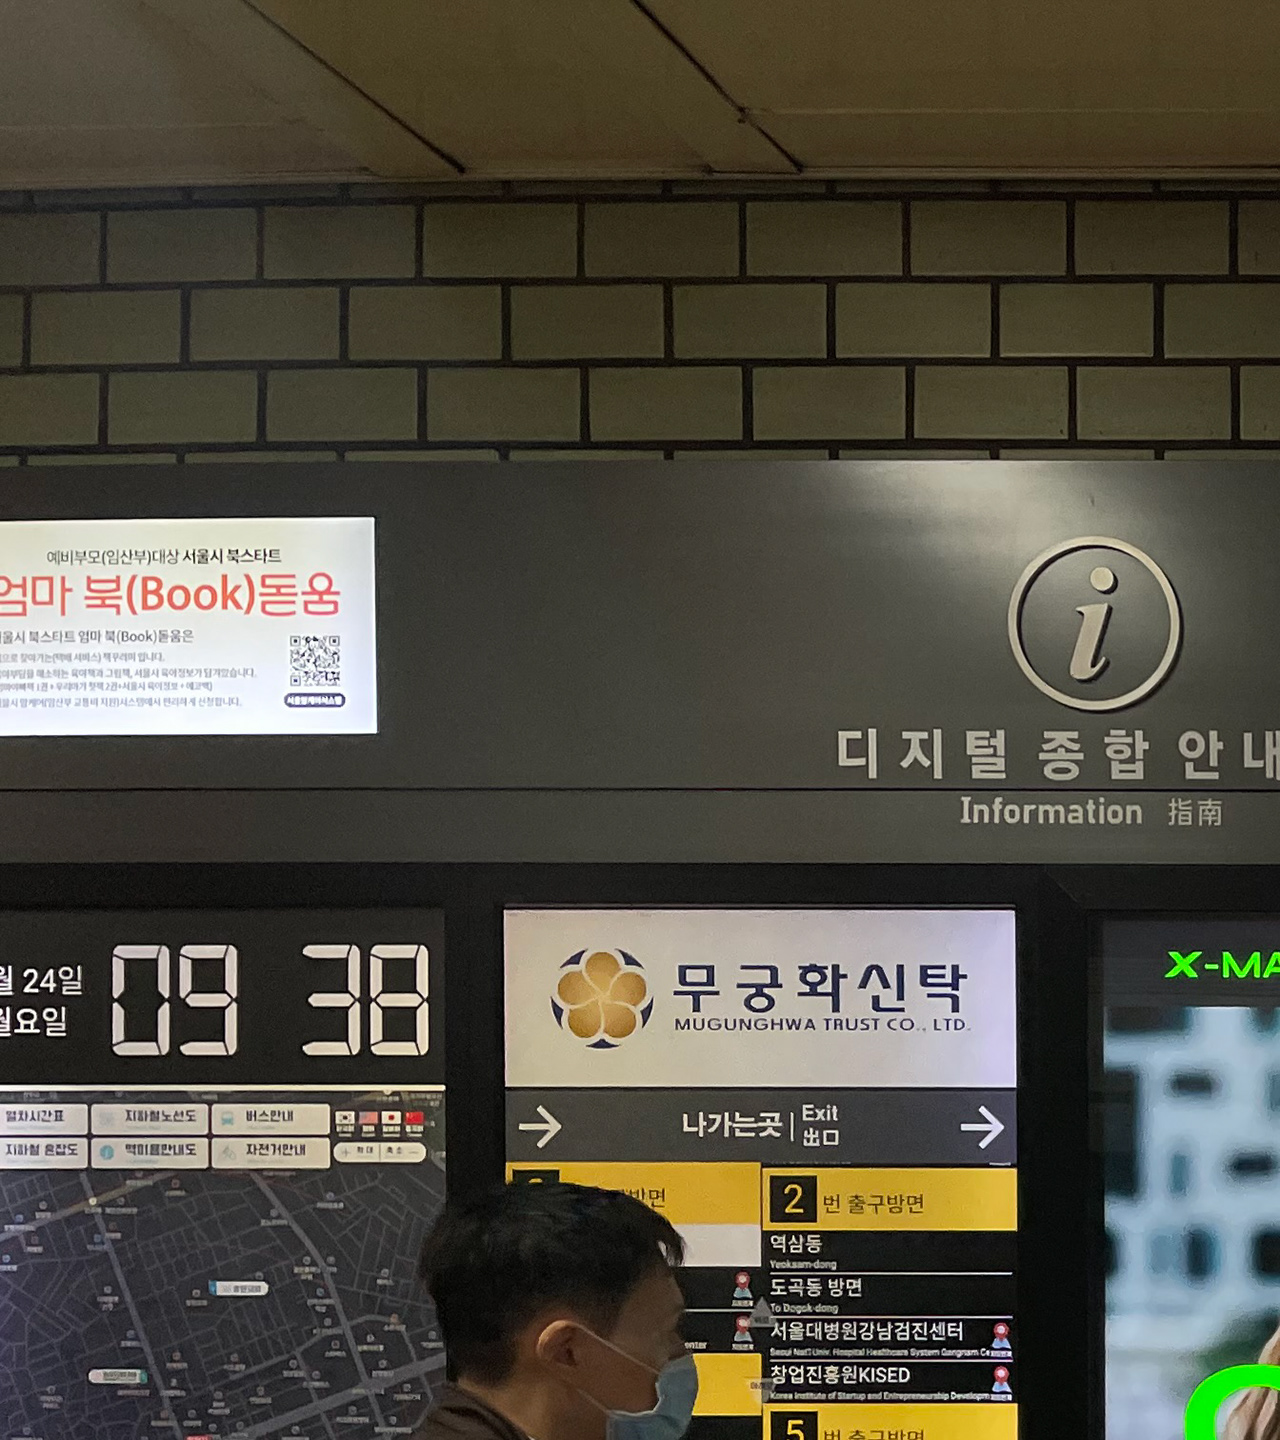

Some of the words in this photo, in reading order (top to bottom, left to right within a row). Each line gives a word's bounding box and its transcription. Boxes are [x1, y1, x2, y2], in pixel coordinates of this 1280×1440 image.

[47, 549, 179, 566] 예비부모(임산부)대상
[183, 548, 224, 564] 서울시
[226, 548, 282, 564] 북스타트
[84, 571, 342, 618] 북(Book)돋움
[29, 630, 75, 644] 북스타트
[78, 630, 101, 644] 엄마
[837, 728, 1007, 780] 디지털
[1038, 729, 1150, 781] 종합
[961, 795, 1143, 826] Information
[1168, 798, 1223, 827] 指南
[23, 965, 83, 995] 24일
[672, 963, 969, 1014] 무궁화신탁
[112, 944, 238, 1057] 09
[302, 944, 429, 1057] 38
[674, 1018, 816, 1032] MUGUNGHWA
[824, 1018, 882, 1032] TRUST
[933, 1017, 972, 1032] LTD.
[6, 1110, 64, 1122] 열차시간표
[125, 1110, 196, 1122] 지하철노선도
[245, 1110, 294, 1122] 버스안내
[802, 1104, 838, 1122] Exit
[682, 1112, 783, 1140] 나가는곳
[803, 1128, 840, 1147] 出口
[5, 1143, 40, 1156] 지하철
[246, 1143, 306, 1156] 자전거안내
[784, 1183, 804, 1214] 2
[823, 1195, 840, 1214] 번
[848, 1193, 925, 1215] 출구방면
[770, 1234, 822, 1253] 역삼동
[770, 1278, 822, 1297] 도곡동
[828, 1278, 862, 1297] 방면
[770, 1303, 781, 1313] To
[770, 1321, 964, 1341] 서울대병원강남검진센터
[770, 1365, 911, 1385] 창업진흥원KISED
[951, 1391, 991, 1402] Developm
